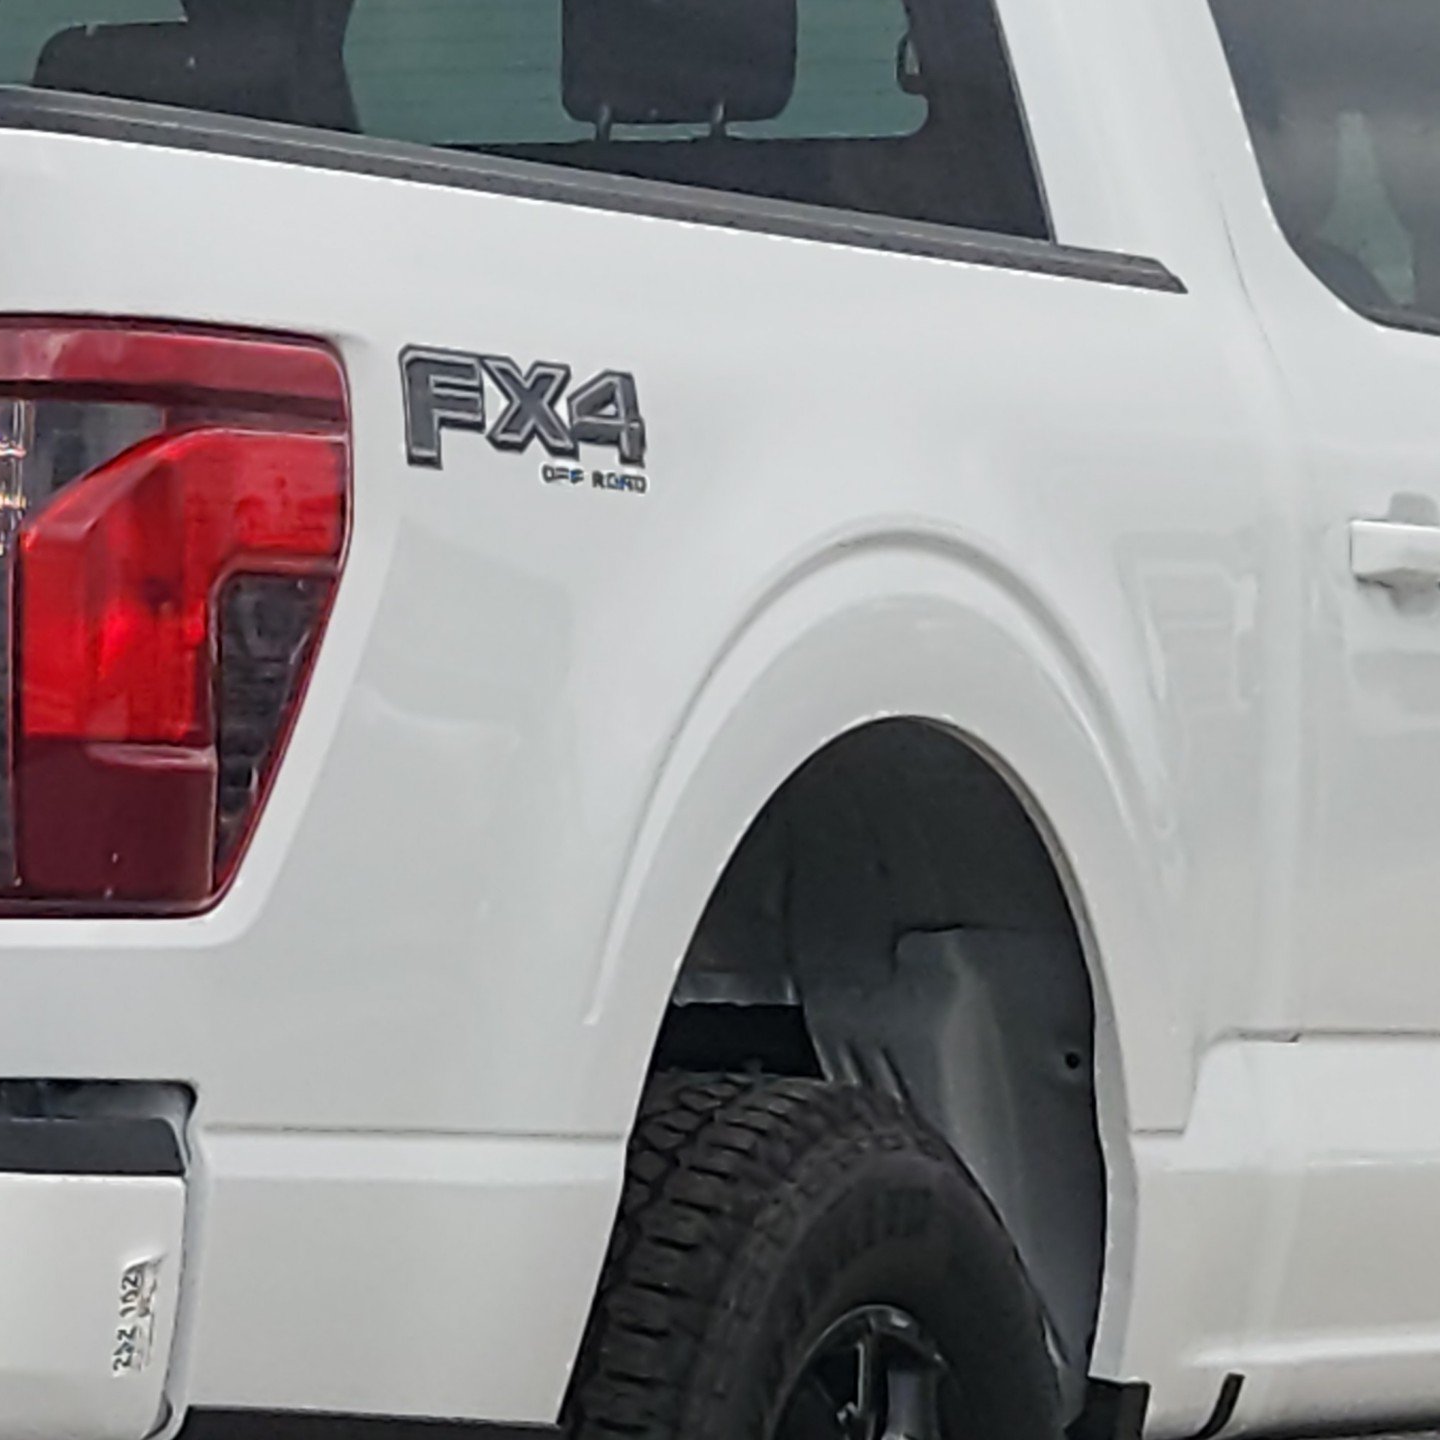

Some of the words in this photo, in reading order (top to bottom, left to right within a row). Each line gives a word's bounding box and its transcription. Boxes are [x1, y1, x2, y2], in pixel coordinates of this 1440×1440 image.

[398, 343, 647, 471] FX4
[542, 463, 584, 484] OFF
[592, 470, 647, 494] ROAD
